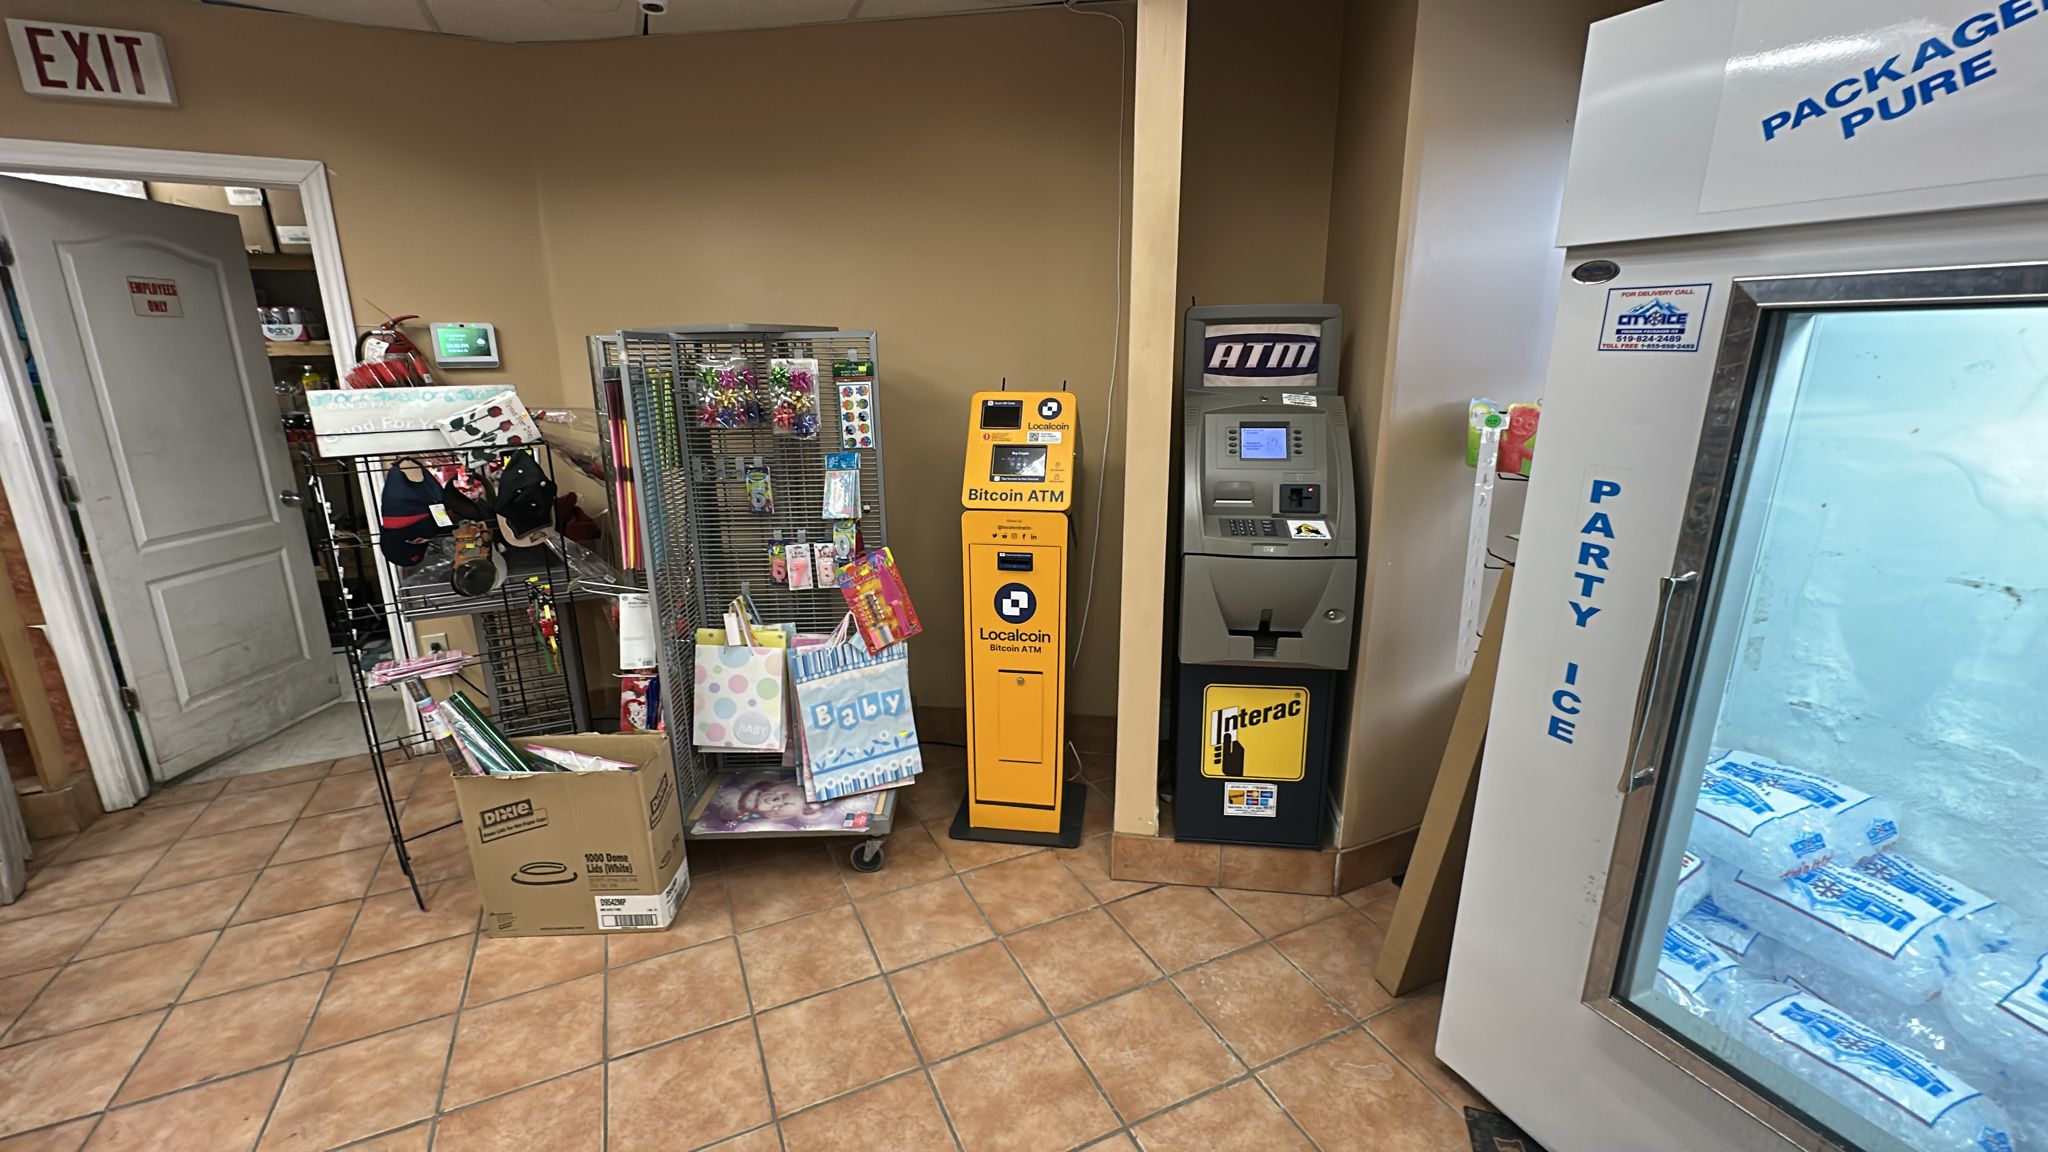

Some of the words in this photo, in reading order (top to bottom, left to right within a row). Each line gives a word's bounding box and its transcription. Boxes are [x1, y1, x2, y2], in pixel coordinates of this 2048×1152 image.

[25, 27, 146, 95] EXIT
[1762, 0, 2048, 141] PACKAGE
[1840, 49, 1997, 140] PURE
[129, 281, 178, 297] EMPLOYEES
[1637, 289, 1673, 297] DELIVERY
[147, 299, 168, 313] ONLY
[1658, 312, 1689, 325] ICE
[1616, 335, 1682, 343] 519-824-2489
[1208, 342, 1317, 369] ATM
[1028, 422, 1069, 431] Localcoin
[968, 488, 1023, 502] Bitcoin
[1028, 490, 1064, 502] ATM
[1568, 479, 1621, 628] PARTY
[980, 627, 1051, 643] Localcoin
[990, 644, 1019, 653] Bitcoin
[1021, 645, 1042, 654] ATM
[815, 694, 900, 726] Baby
[1547, 662, 1582, 744] ICE
[1216, 700, 1301, 745] Interac
[585, 853, 604, 863] 1000
[606, 853, 629, 862] Dome
[586, 864, 604, 874] Lids
[605, 863, 633, 874] (White)
